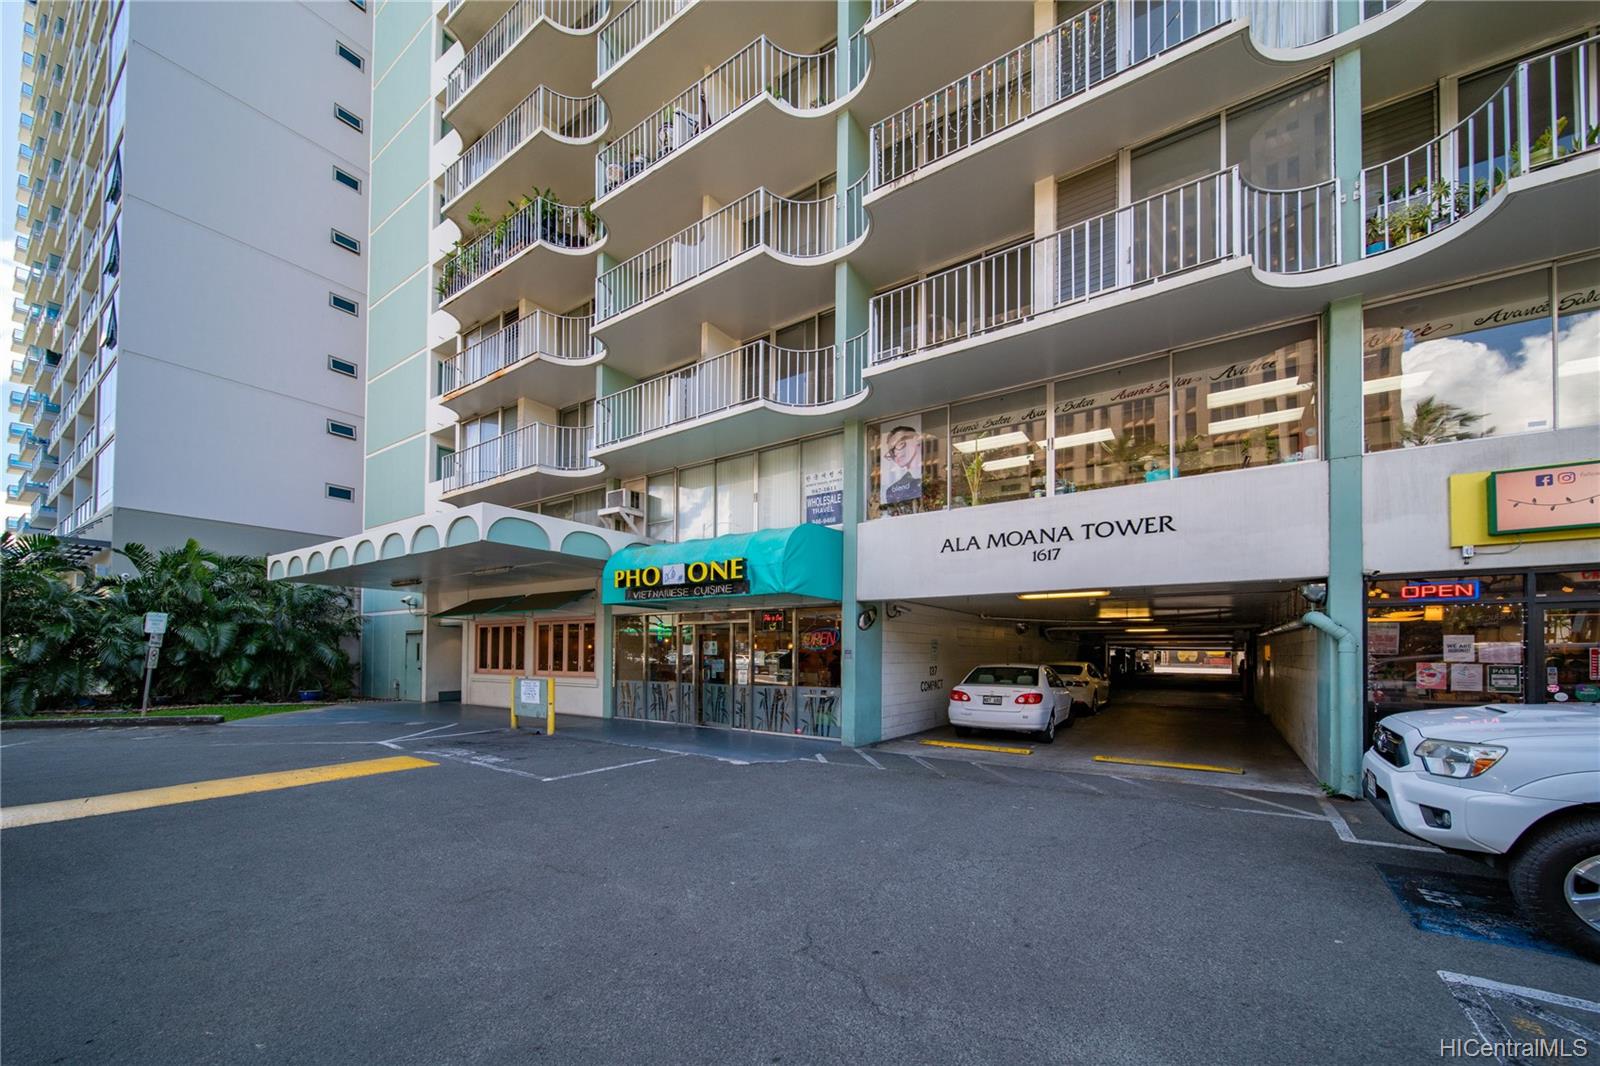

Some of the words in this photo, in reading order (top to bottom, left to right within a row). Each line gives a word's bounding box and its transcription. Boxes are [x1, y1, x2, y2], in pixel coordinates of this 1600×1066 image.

[807, 493, 842, 507] WHOLESALE
[812, 506, 835, 514] TRAVEL
[940, 537, 981, 553] ALA
[987, 526, 1074, 549] MOANA
[1081, 514, 1177, 540] TOWER
[1032, 548, 1061, 562] 1617
[614, 567, 661, 588] PHO
[687, 558, 743, 581] ONE
[633, 587, 689, 600] VIETNAMESE
[694, 583, 734, 596] CUISINE
[1401, 584, 1474, 598] OPEN
[920, 679, 944, 692] COMPACT
